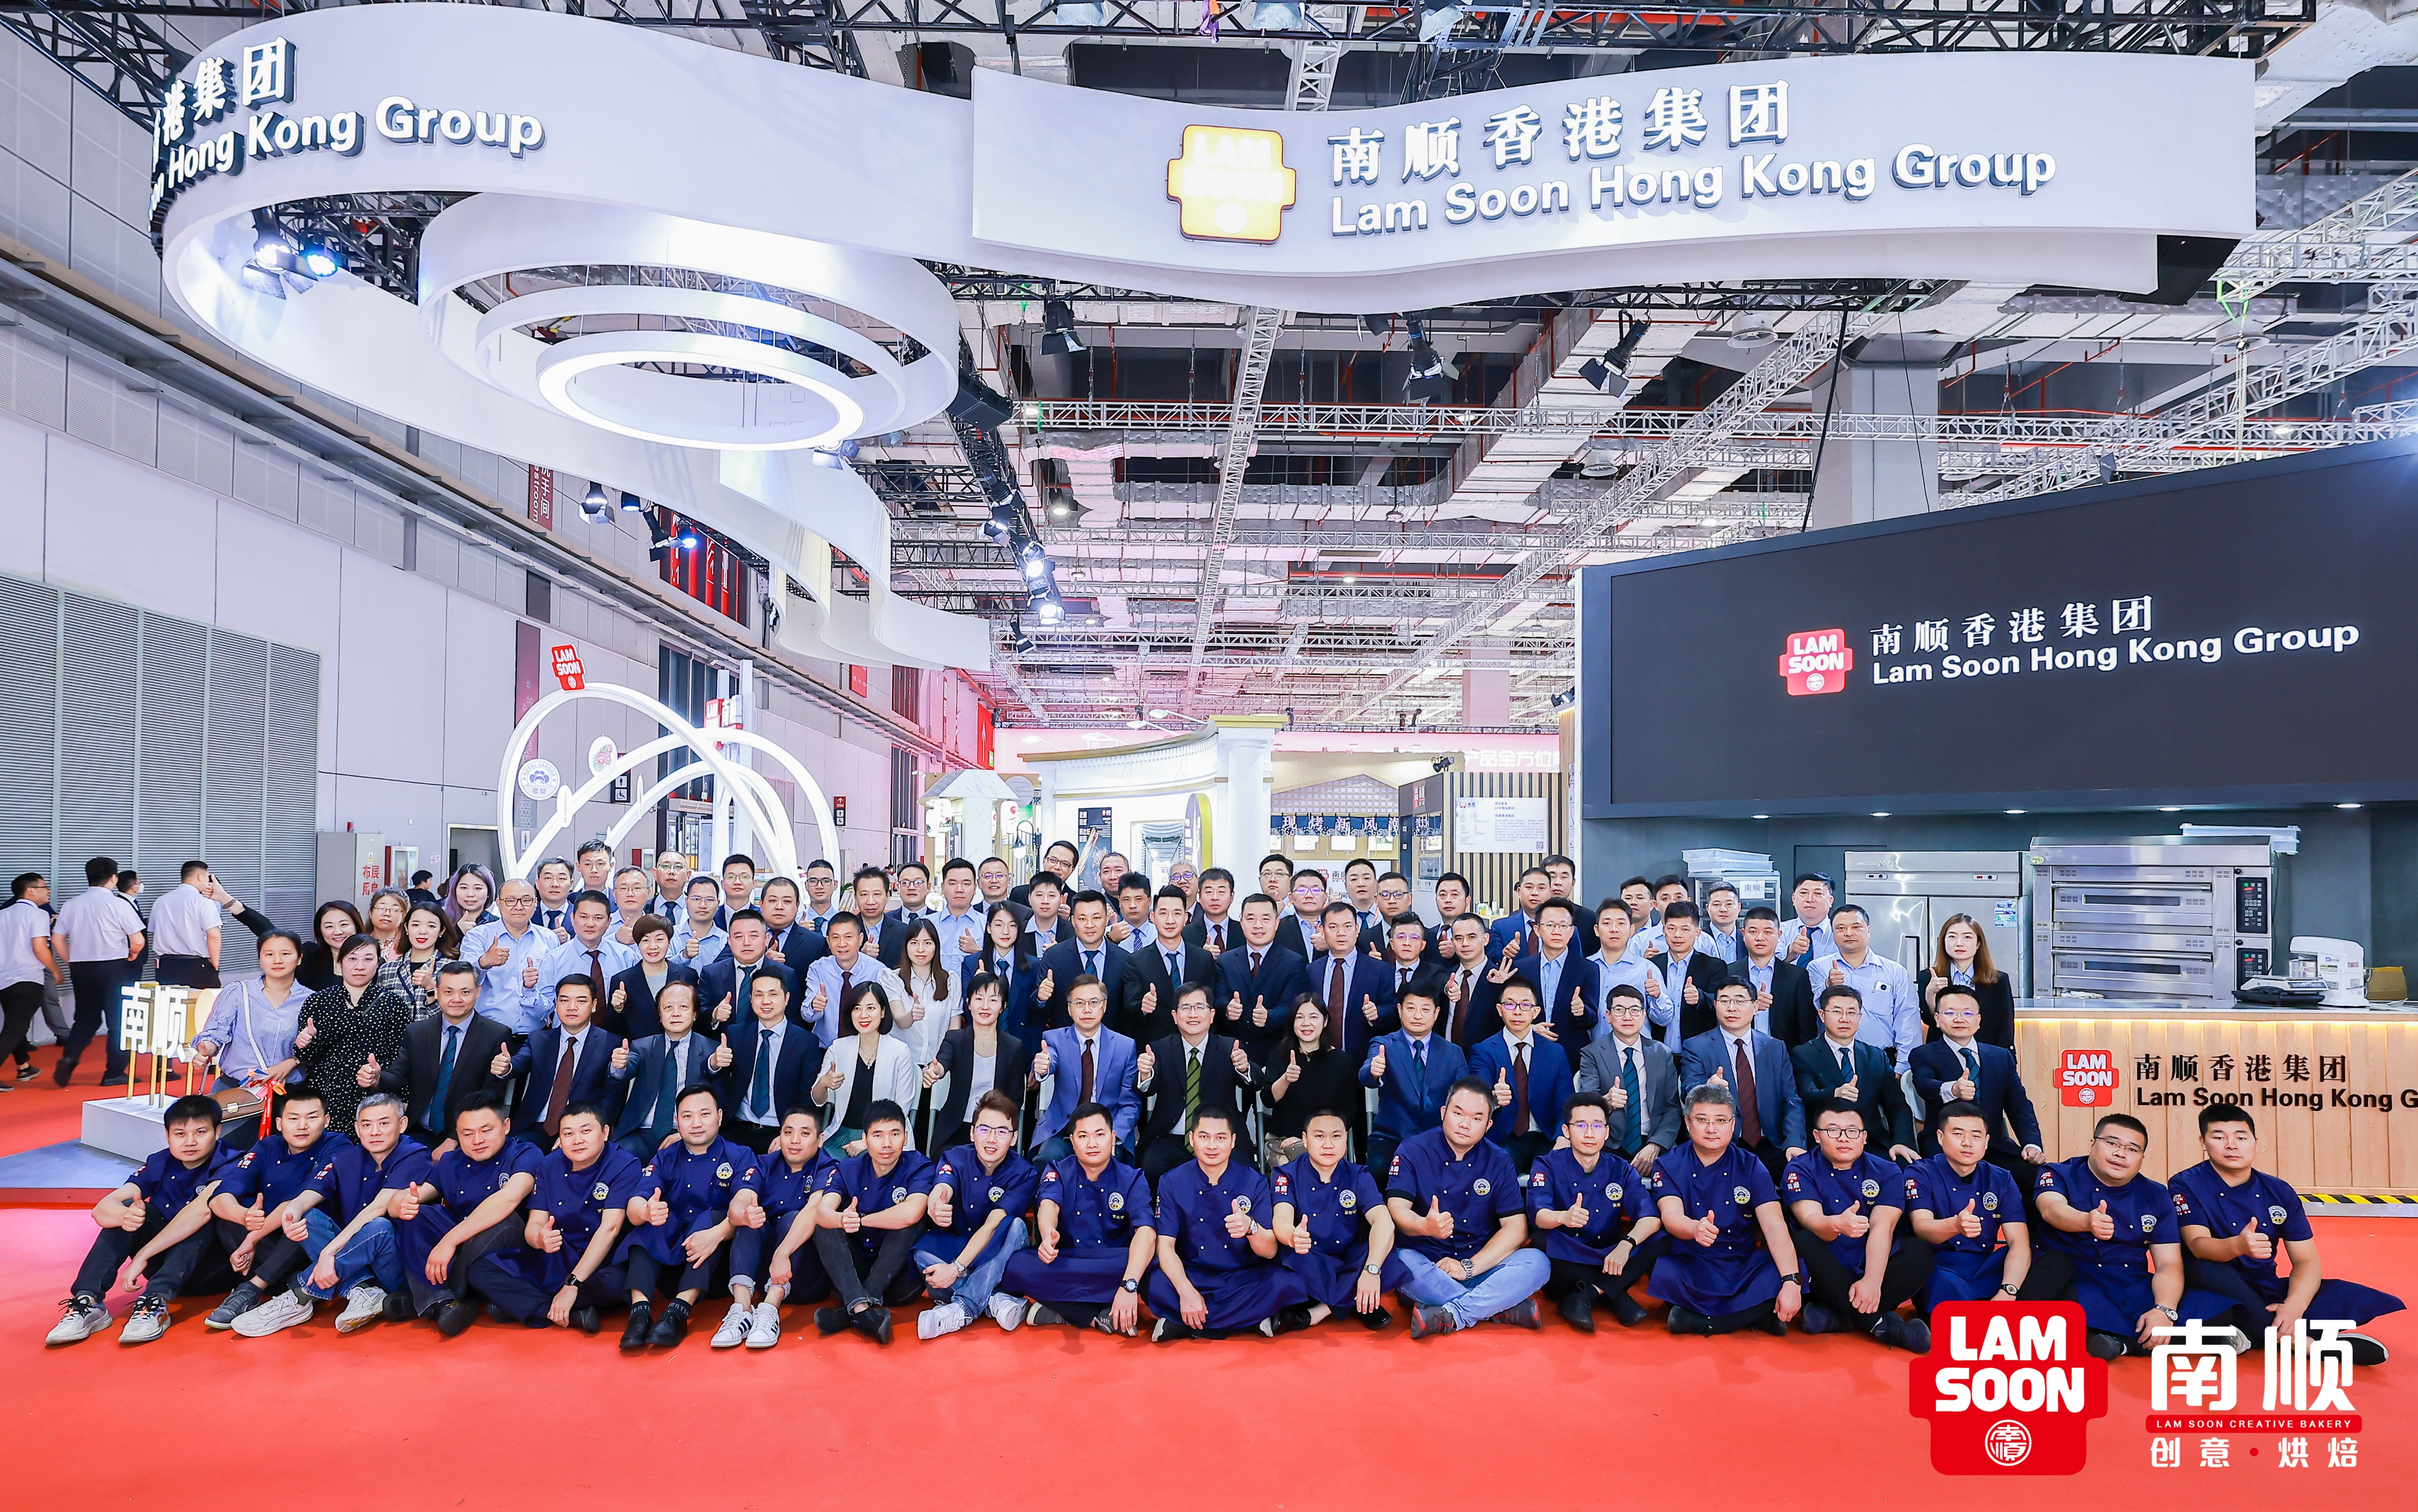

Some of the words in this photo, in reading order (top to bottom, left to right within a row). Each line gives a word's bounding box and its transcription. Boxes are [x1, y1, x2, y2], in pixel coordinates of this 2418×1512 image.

[152, 36, 287, 172] 港集团
[169, 131, 235, 188] Hong
[249, 111, 358, 155] Kong
[375, 96, 544, 155] Group
[1328, 79, 1790, 184] 南顺香港集团
[1332, 197, 1427, 234] Lam
[1445, 181, 1568, 224] Soon
[1590, 164, 1723, 207] Hong
[1741, 152, 1876, 199] Kong
[1895, 143, 2056, 194] Group
[1869, 594, 2153, 657] 南顺香港集团
[554, 648, 575, 662] LAM
[1793, 634, 1838, 656] LAM
[1873, 662, 1932, 685] Lam
[1941, 654, 2020, 679] Soon
[2030, 646, 2117, 672] Hong
[2129, 637, 2222, 663] Kong
[2233, 625, 2360, 653] Group
[556, 661, 581, 676] SOON
[1788, 652, 1844, 674] SOON
[523, 762, 536, 775] ROYAL
[538, 762, 555, 777] SAKURA
[1744, 884, 1760, 892] 南顺
[120, 981, 191, 1062] 南顺
[2067, 1054, 2106, 1070] LAM
[2134, 1053, 2347, 1083] 南顺香港集团
[2062, 1070, 2113, 1087] SOON
[2137, 1087, 2186, 1106] Lam
[2194, 1087, 2254, 1106] Soon
[2261, 1087, 2323, 1112] Hong
[2331, 1088, 2393, 1112] Kong
